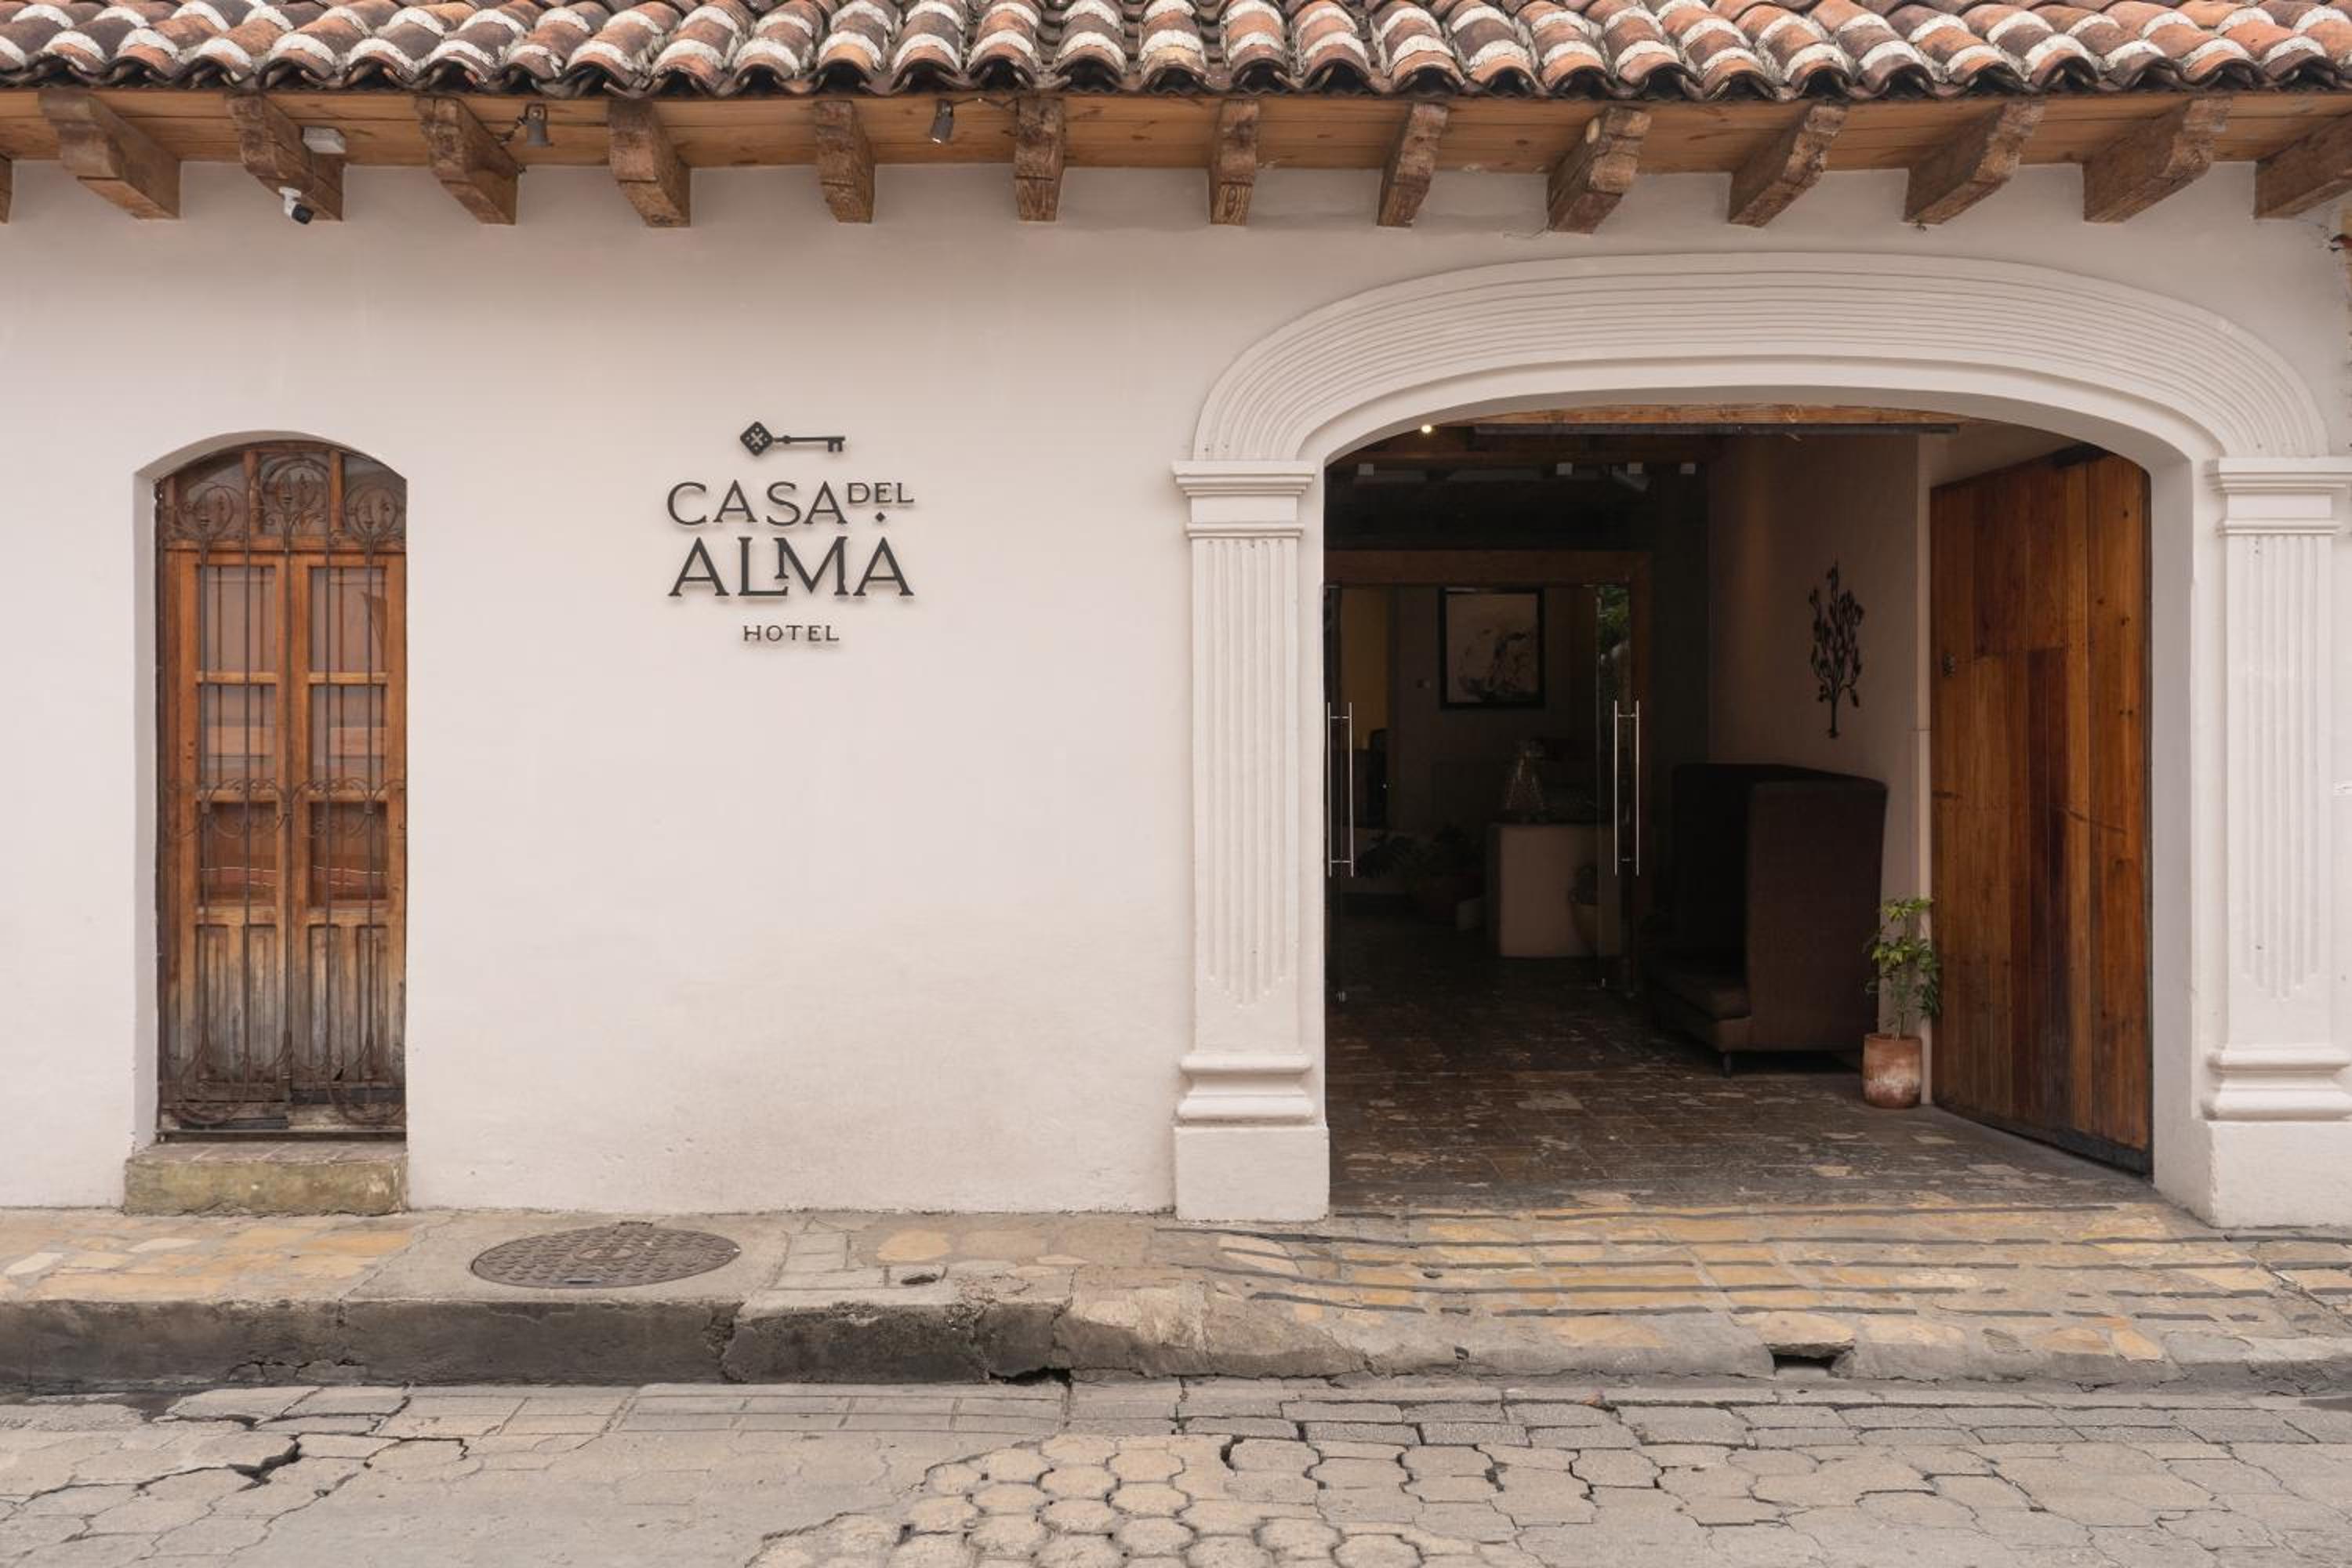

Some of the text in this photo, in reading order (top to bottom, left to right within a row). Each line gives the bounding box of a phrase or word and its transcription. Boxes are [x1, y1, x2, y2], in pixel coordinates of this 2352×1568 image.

[667, 479, 915, 527] CASA DEL
[668, 535, 915, 597] ALMA
[742, 625, 840, 642] HOTEL
